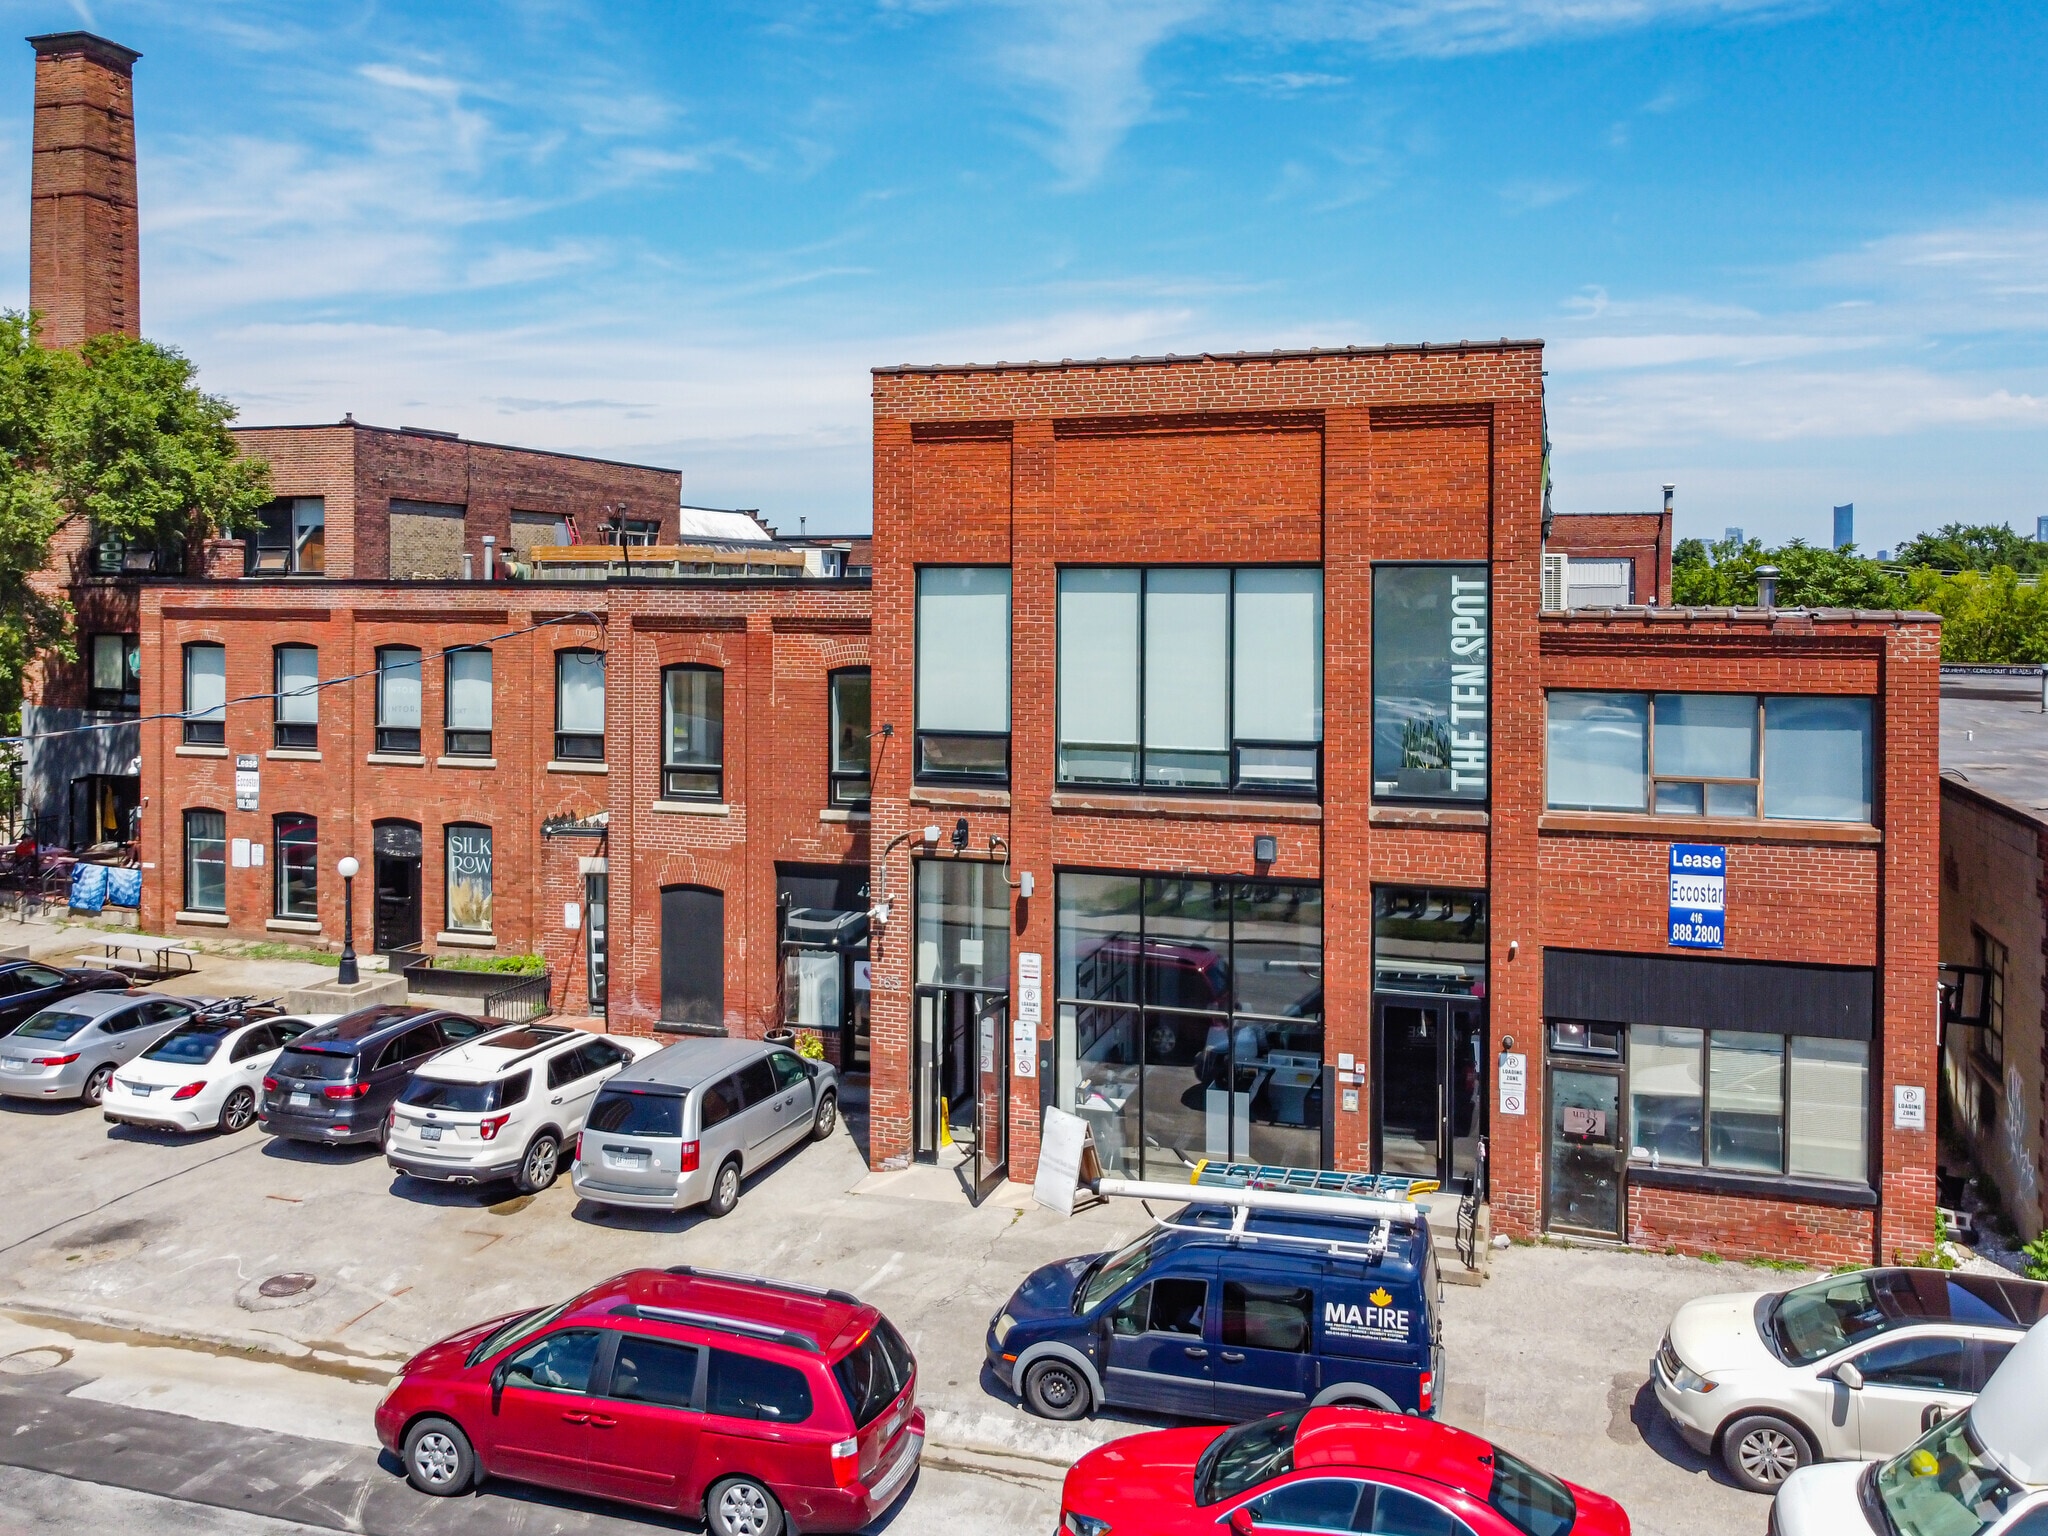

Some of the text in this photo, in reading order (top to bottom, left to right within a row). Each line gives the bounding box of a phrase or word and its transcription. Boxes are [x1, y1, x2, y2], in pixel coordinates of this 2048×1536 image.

[1450, 574, 1486, 792] THE TEN SPOT
[236, 757, 258, 768] Lease
[451, 835, 492, 855] SILK
[451, 855, 492, 874] ROW
[1672, 849, 1722, 869] Lease
[1672, 880, 1722, 903] Eccostar
[1690, 912, 1703, 924] 416
[1673, 923, 1720, 943] 888.2800
[1585, 1117, 1597, 1134] 2
[1325, 1302, 1409, 1331] MA FIRE
